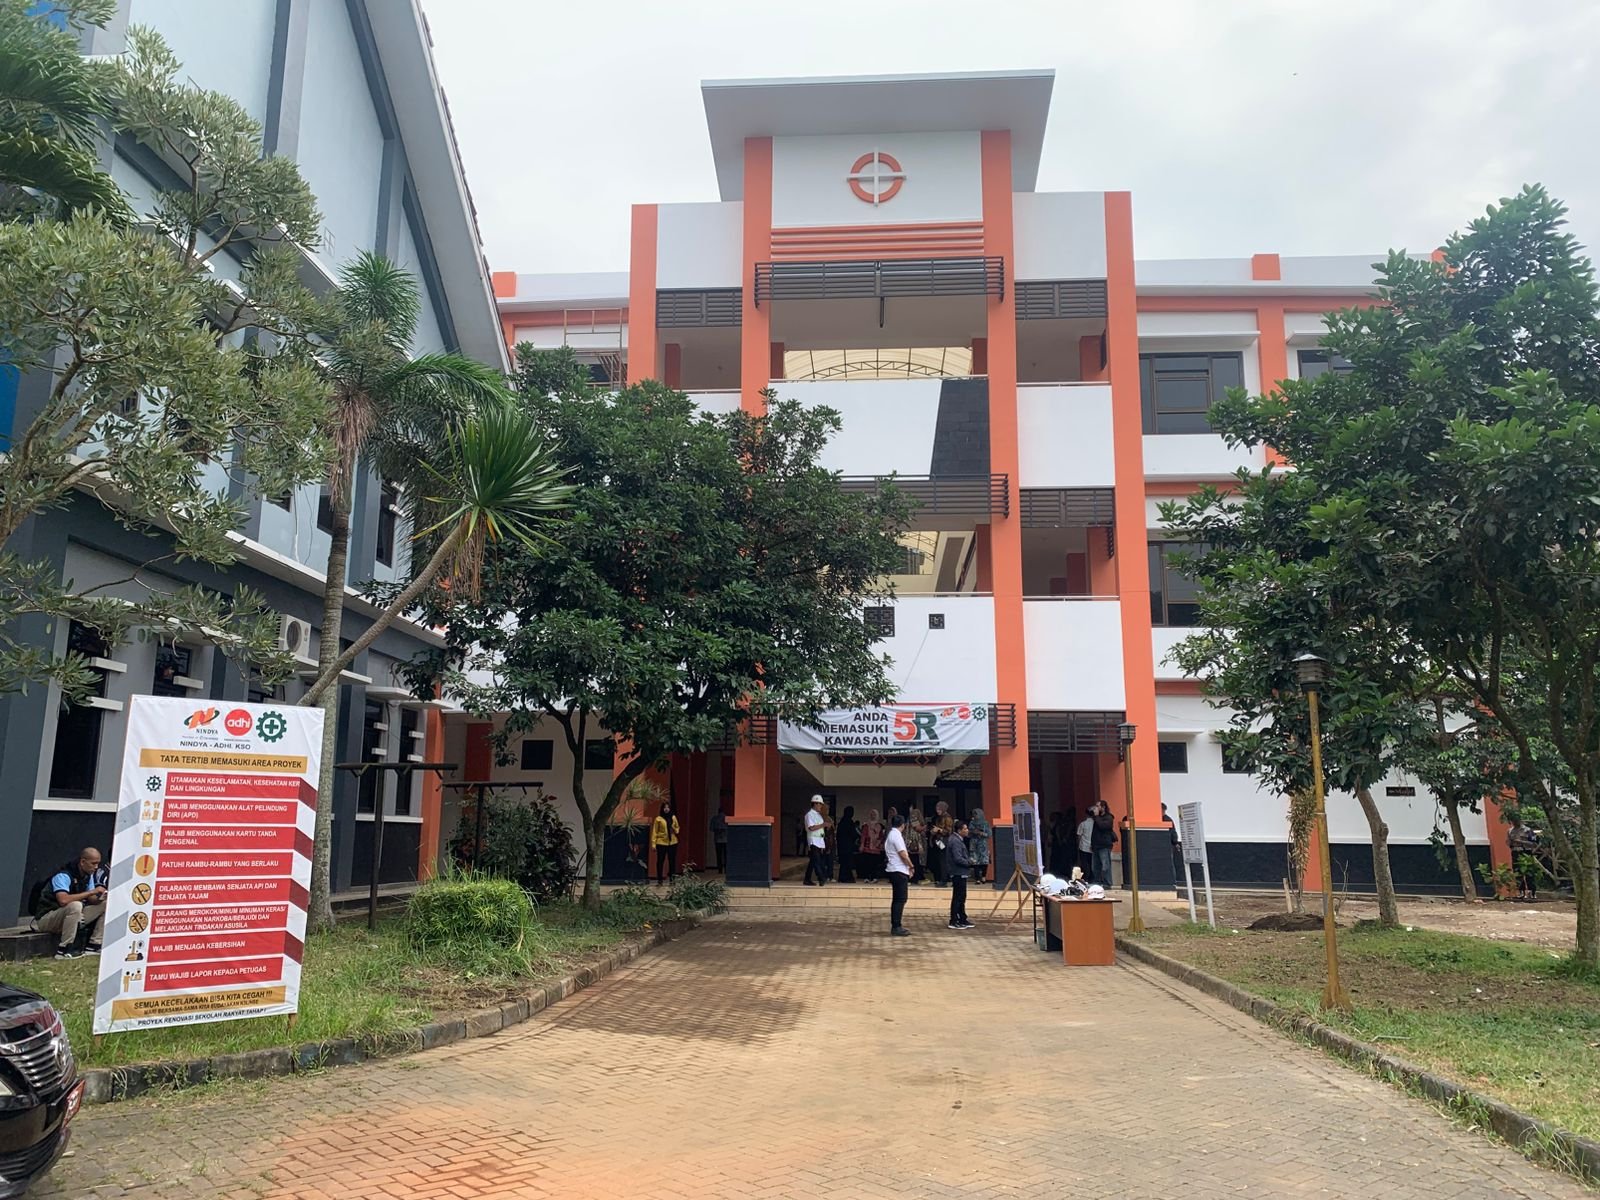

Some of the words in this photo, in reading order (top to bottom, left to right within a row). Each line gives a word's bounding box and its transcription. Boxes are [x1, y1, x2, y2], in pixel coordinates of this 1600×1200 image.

[854, 713, 888, 721] ANDA
[227, 718, 250, 728] adhi
[894, 712, 939, 740] 5R
[820, 725, 888, 733] MEMASUKI
[825, 736, 888, 745] KAWASAN
[182, 756, 208, 764] TERTIB
[211, 757, 250, 766] MEMASUKI
[251, 758, 271, 767] AREA
[273, 759, 302, 768] PROYEK
[175, 943, 205, 951] MENJAGA
[206, 941, 246, 949] KEBERSIHAN
[240, 966, 266, 974] PETUGAS
[161, 997, 208, 1007] KECELAKAAN
[210, 994, 225, 1002] BISA
[242, 991, 264, 999] CEGAH
[164, 1015, 193, 1024] RENOVASI
